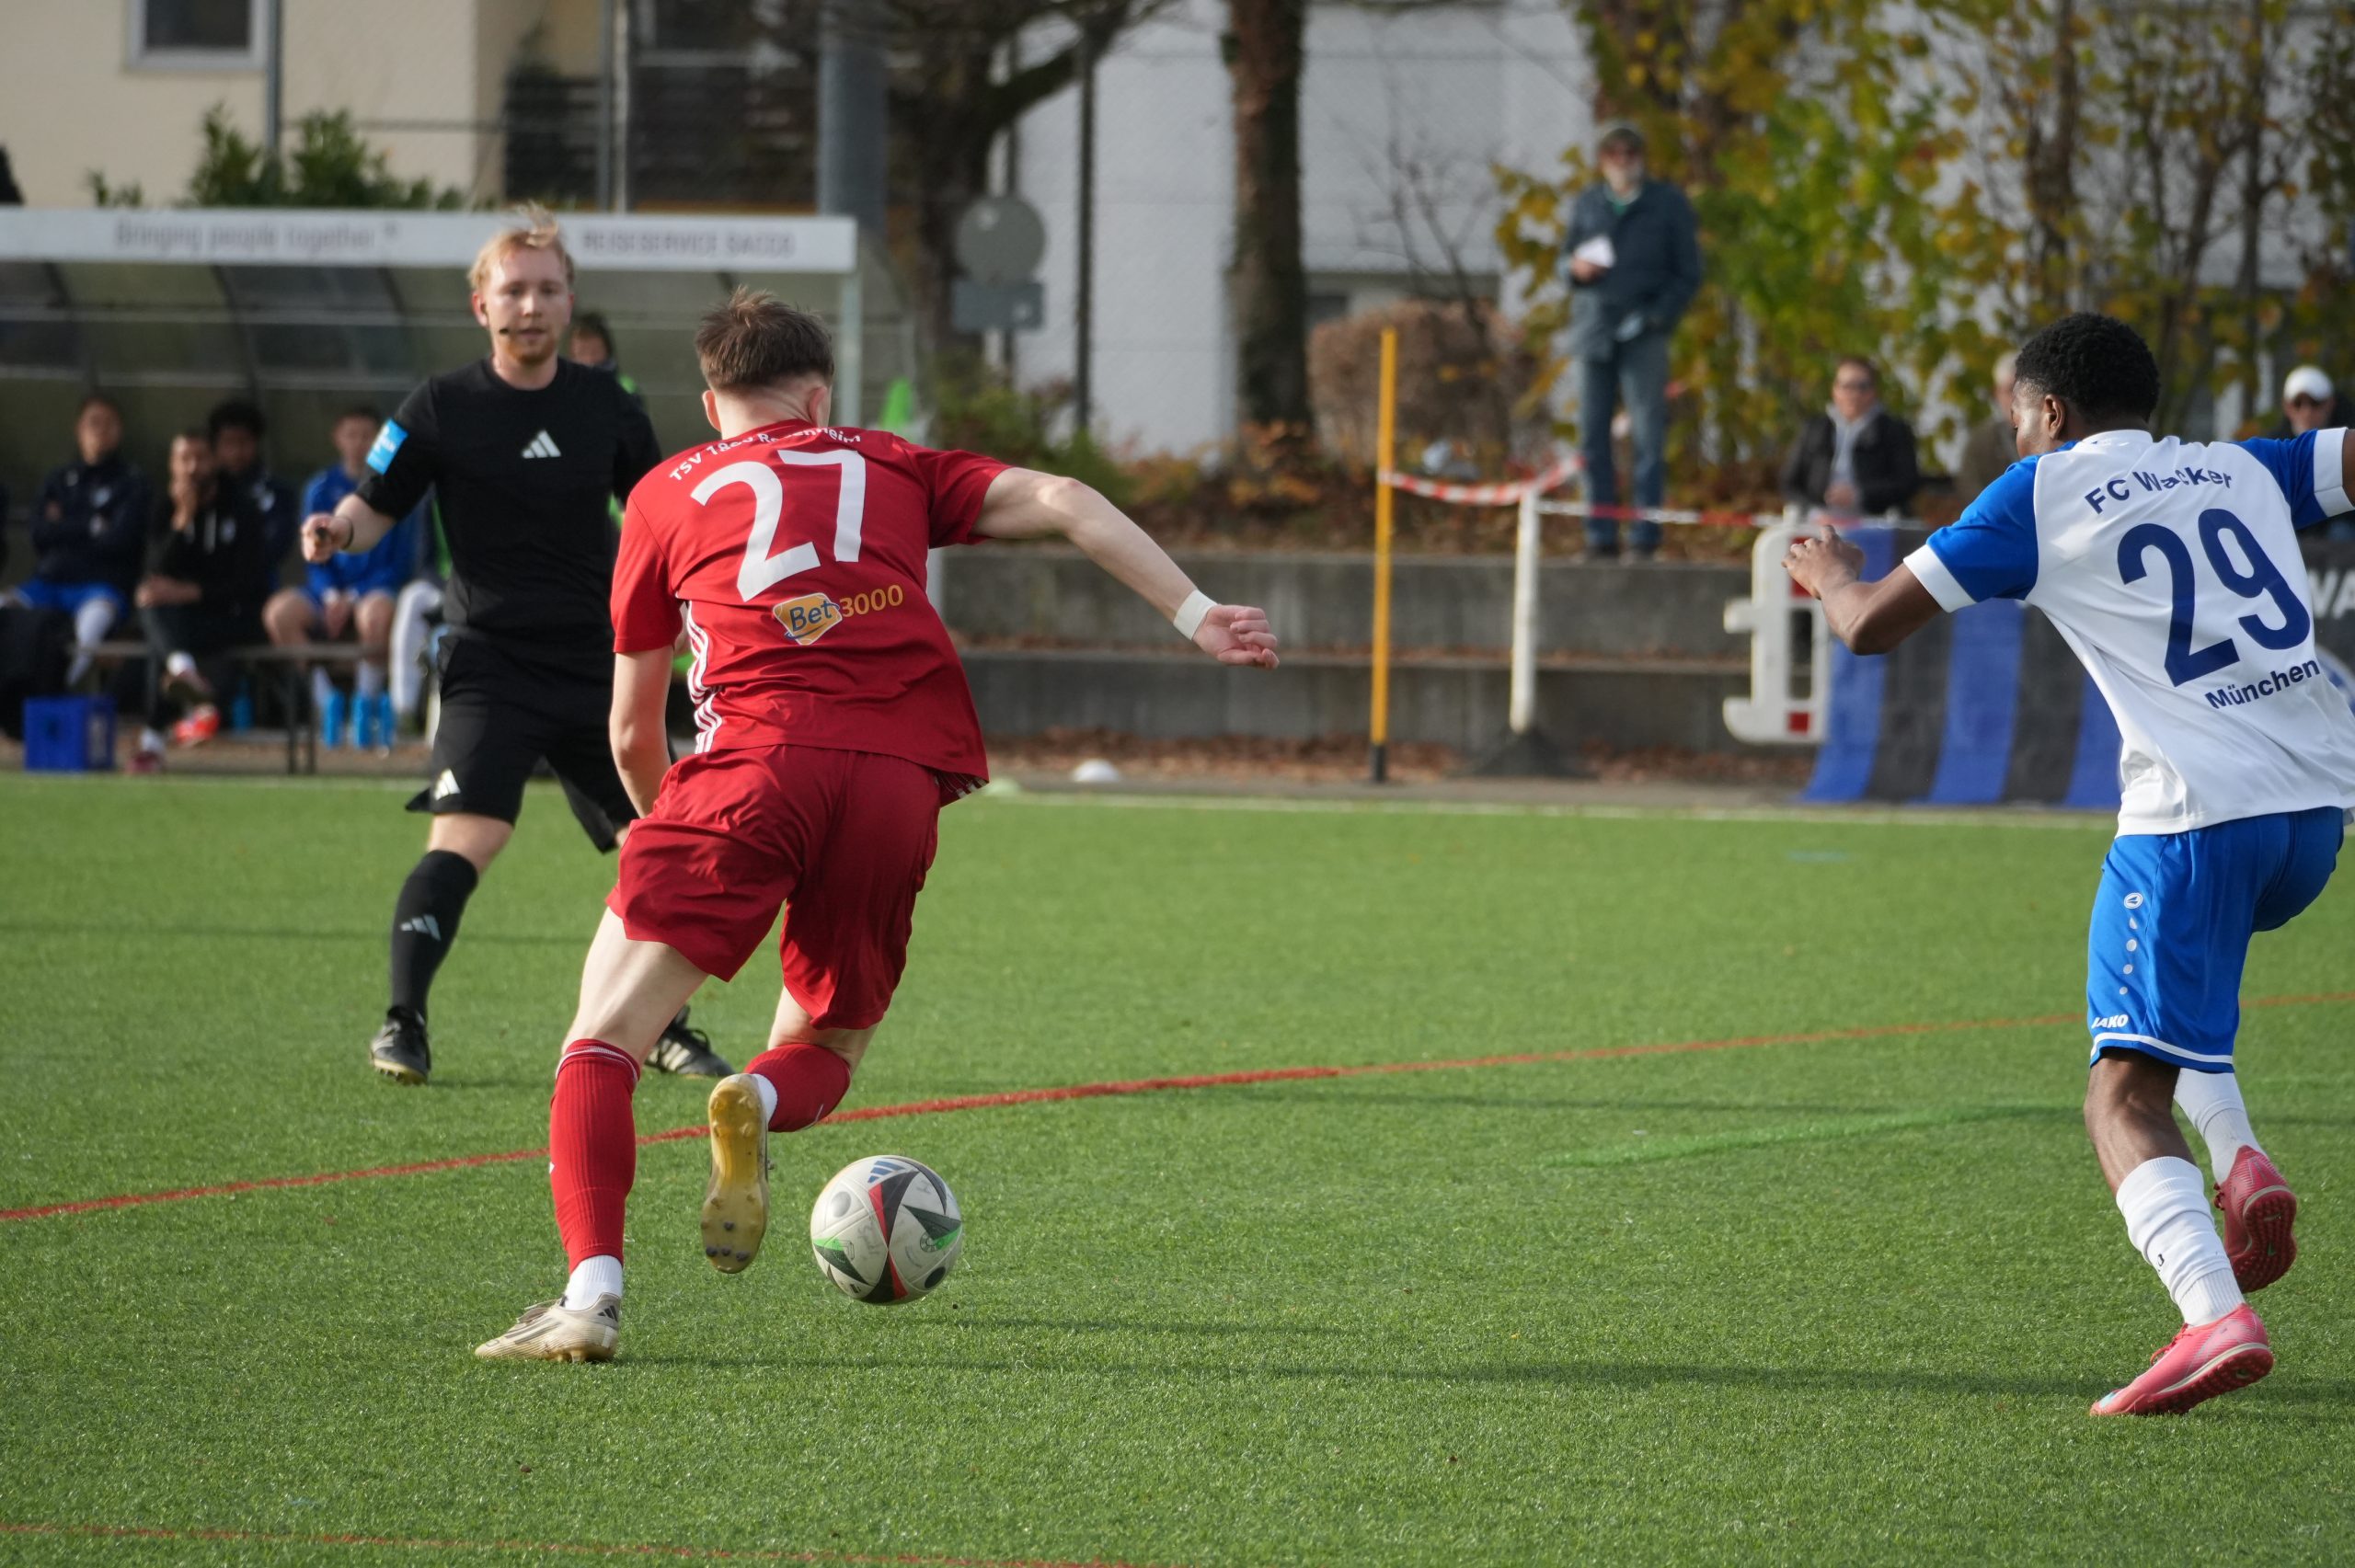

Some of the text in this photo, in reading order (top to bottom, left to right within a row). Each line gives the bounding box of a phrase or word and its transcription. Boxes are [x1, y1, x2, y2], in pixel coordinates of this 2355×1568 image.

[209, 223, 277, 254] people
[670, 452, 702, 481] TSV
[2085, 466, 2232, 514] FC Wacker
[689, 449, 866, 602] 27
[789, 584, 903, 632] Bet 3000
[2117, 508, 2310, 688] 29
[2204, 659, 2320, 709] München
[2091, 1013, 2129, 1029] JAKO
